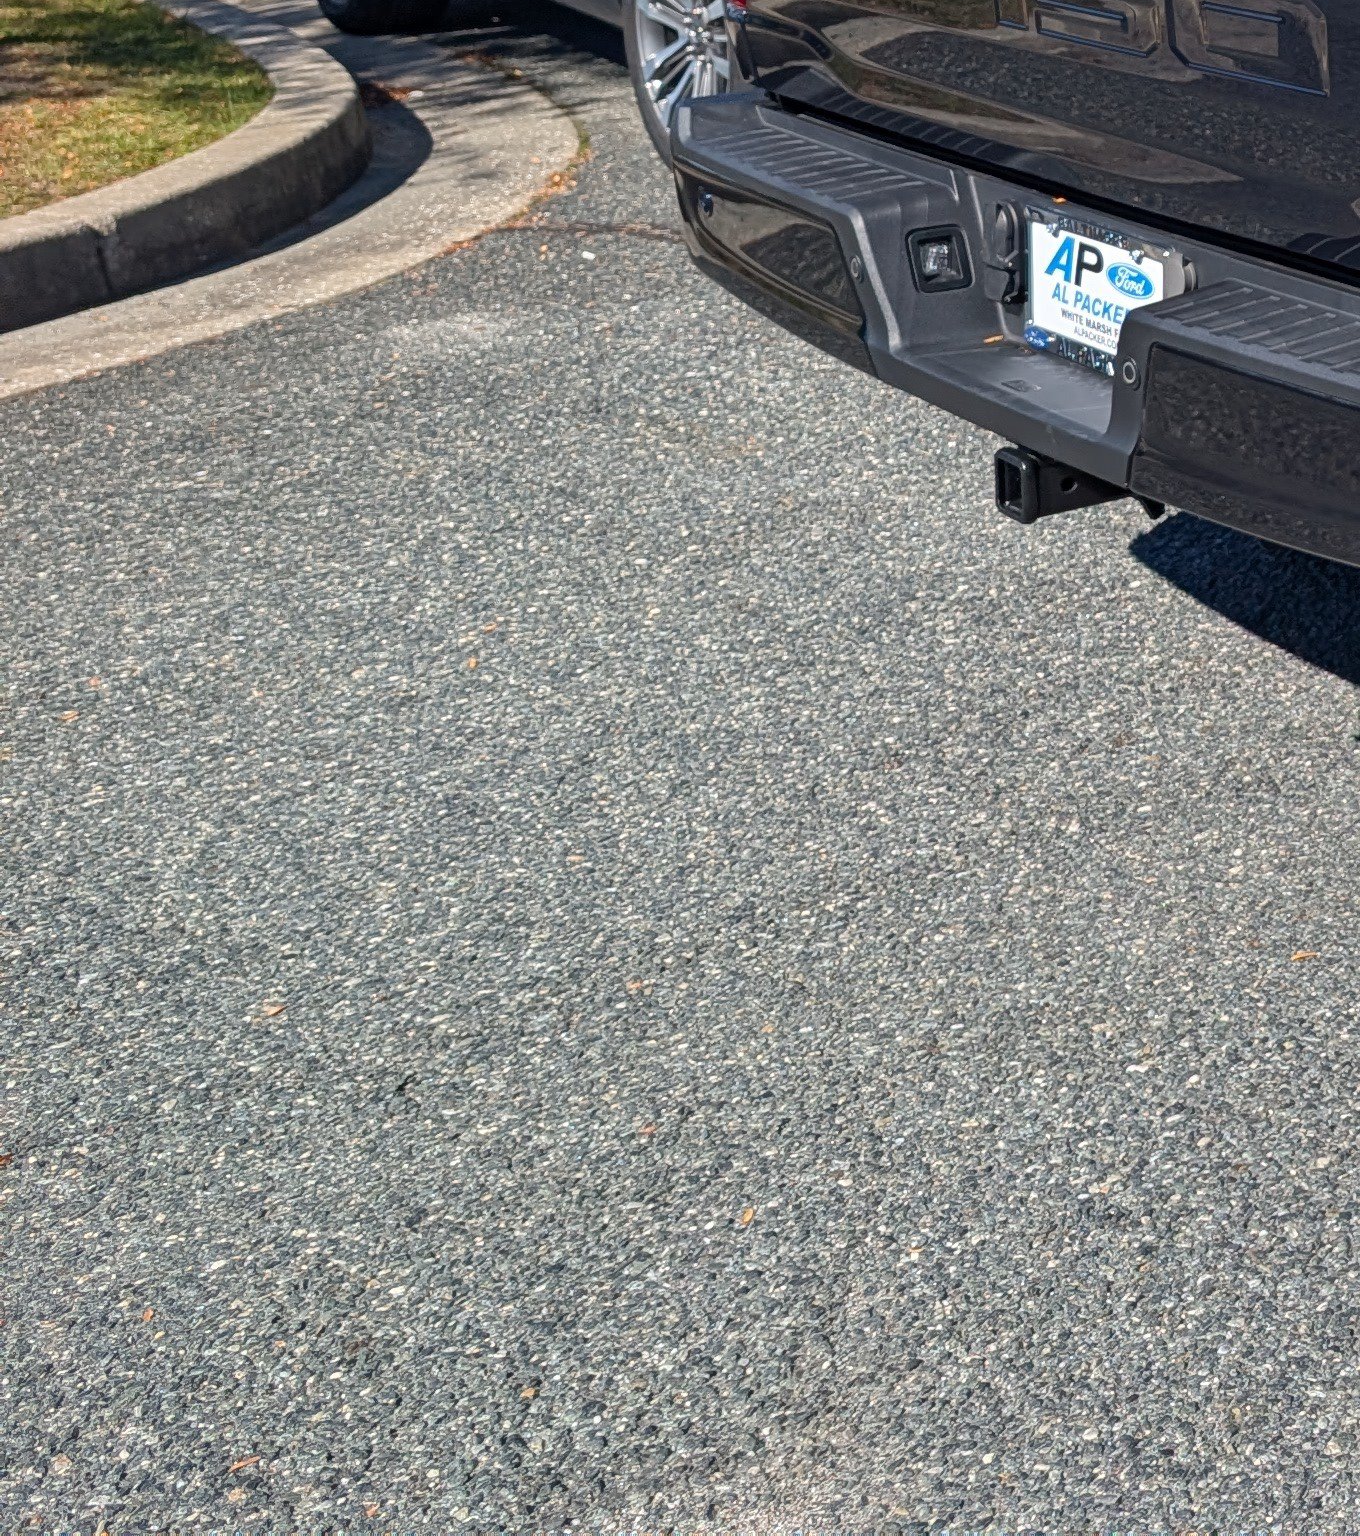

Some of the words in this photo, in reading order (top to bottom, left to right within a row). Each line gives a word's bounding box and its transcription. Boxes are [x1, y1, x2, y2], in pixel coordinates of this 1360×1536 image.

[1045, 235, 1104, 288] AP
[1114, 266, 1146, 295] Ford
[1052, 282, 1069, 304] AL
[1061, 307, 1084, 325] WHITE
[1085, 317, 1112, 337] MARSH
